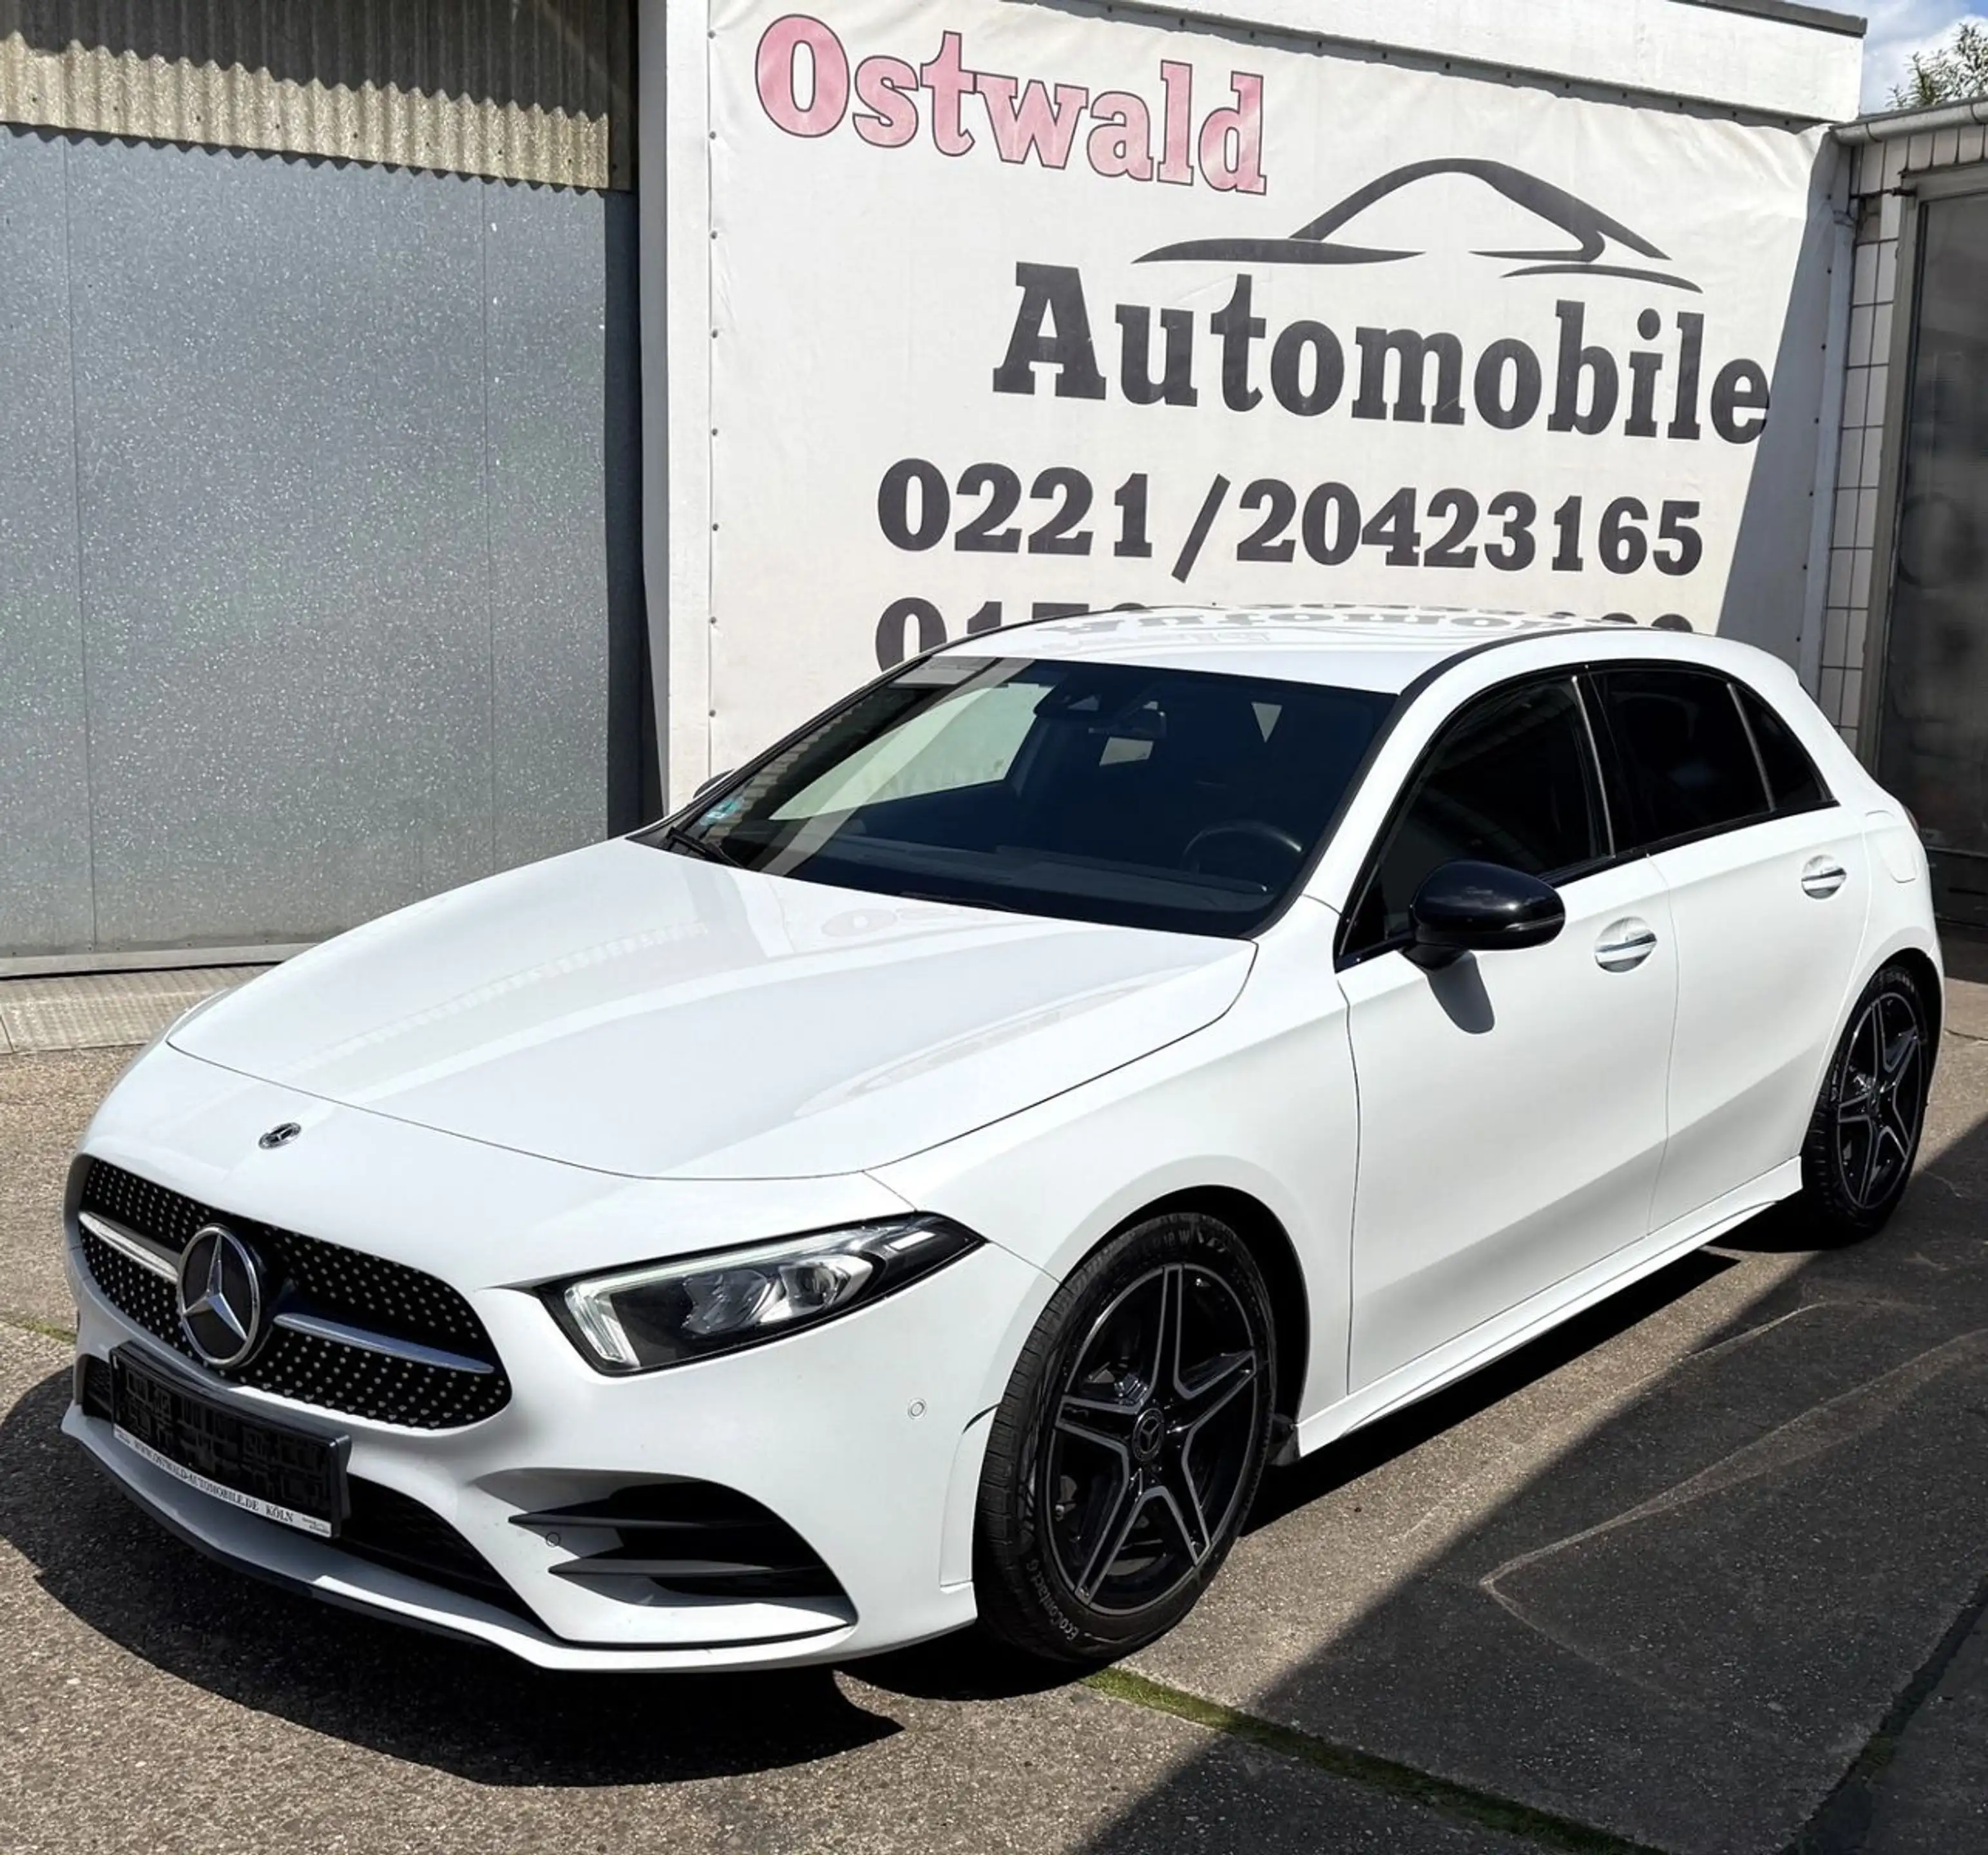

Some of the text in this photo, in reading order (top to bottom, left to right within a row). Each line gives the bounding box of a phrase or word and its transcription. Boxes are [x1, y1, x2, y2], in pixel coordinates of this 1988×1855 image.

[755, 14, 1266, 195] Ostwald
[993, 261, 1770, 444] Automobile
[265, 1503, 294, 1522] KÖLN
[1030, 1571, 1080, 1641] EcoContact
